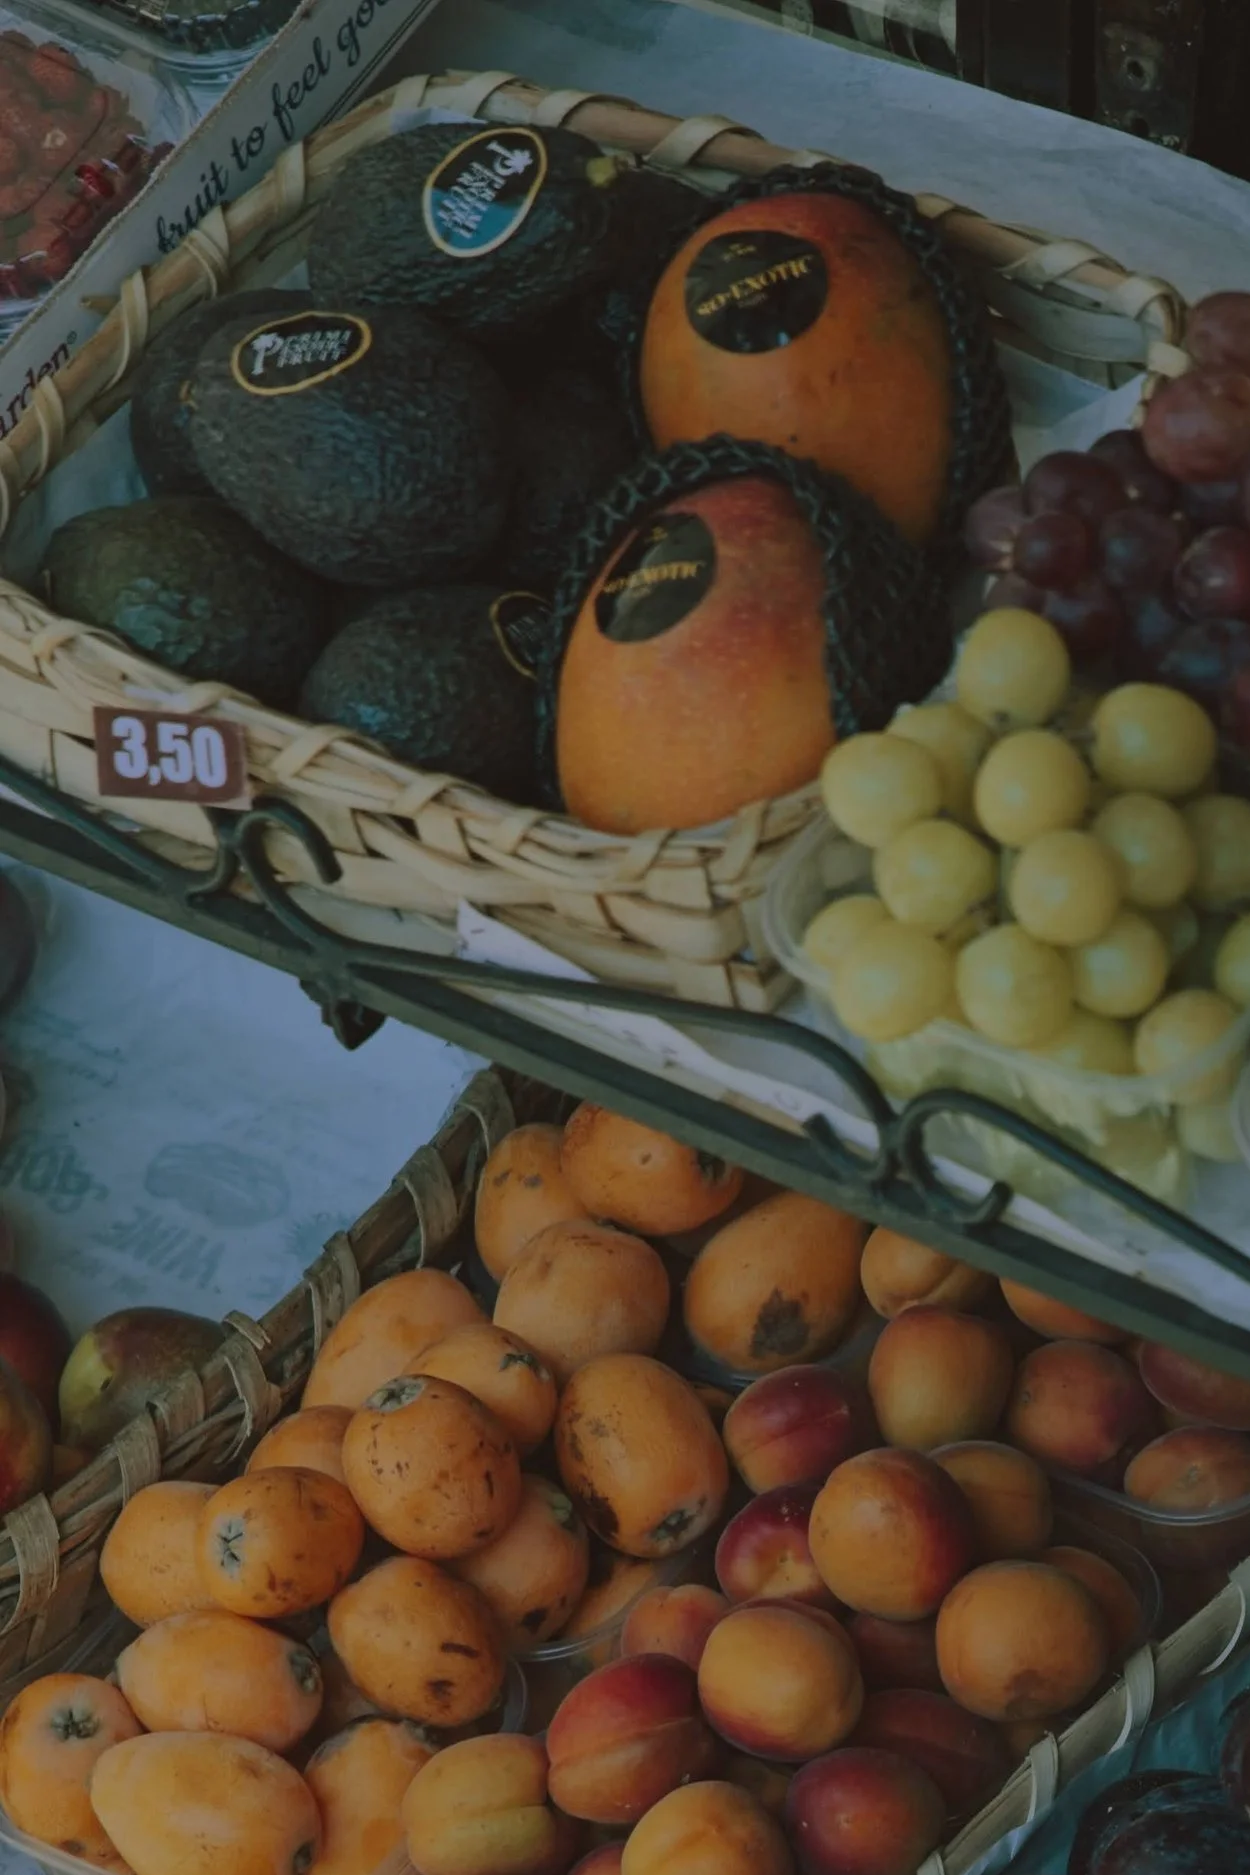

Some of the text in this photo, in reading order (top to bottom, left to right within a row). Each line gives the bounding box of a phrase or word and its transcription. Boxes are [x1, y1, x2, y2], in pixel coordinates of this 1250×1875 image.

[156, 0, 387, 254] fruit to feel go
[111, 715, 228, 789] 3,50
